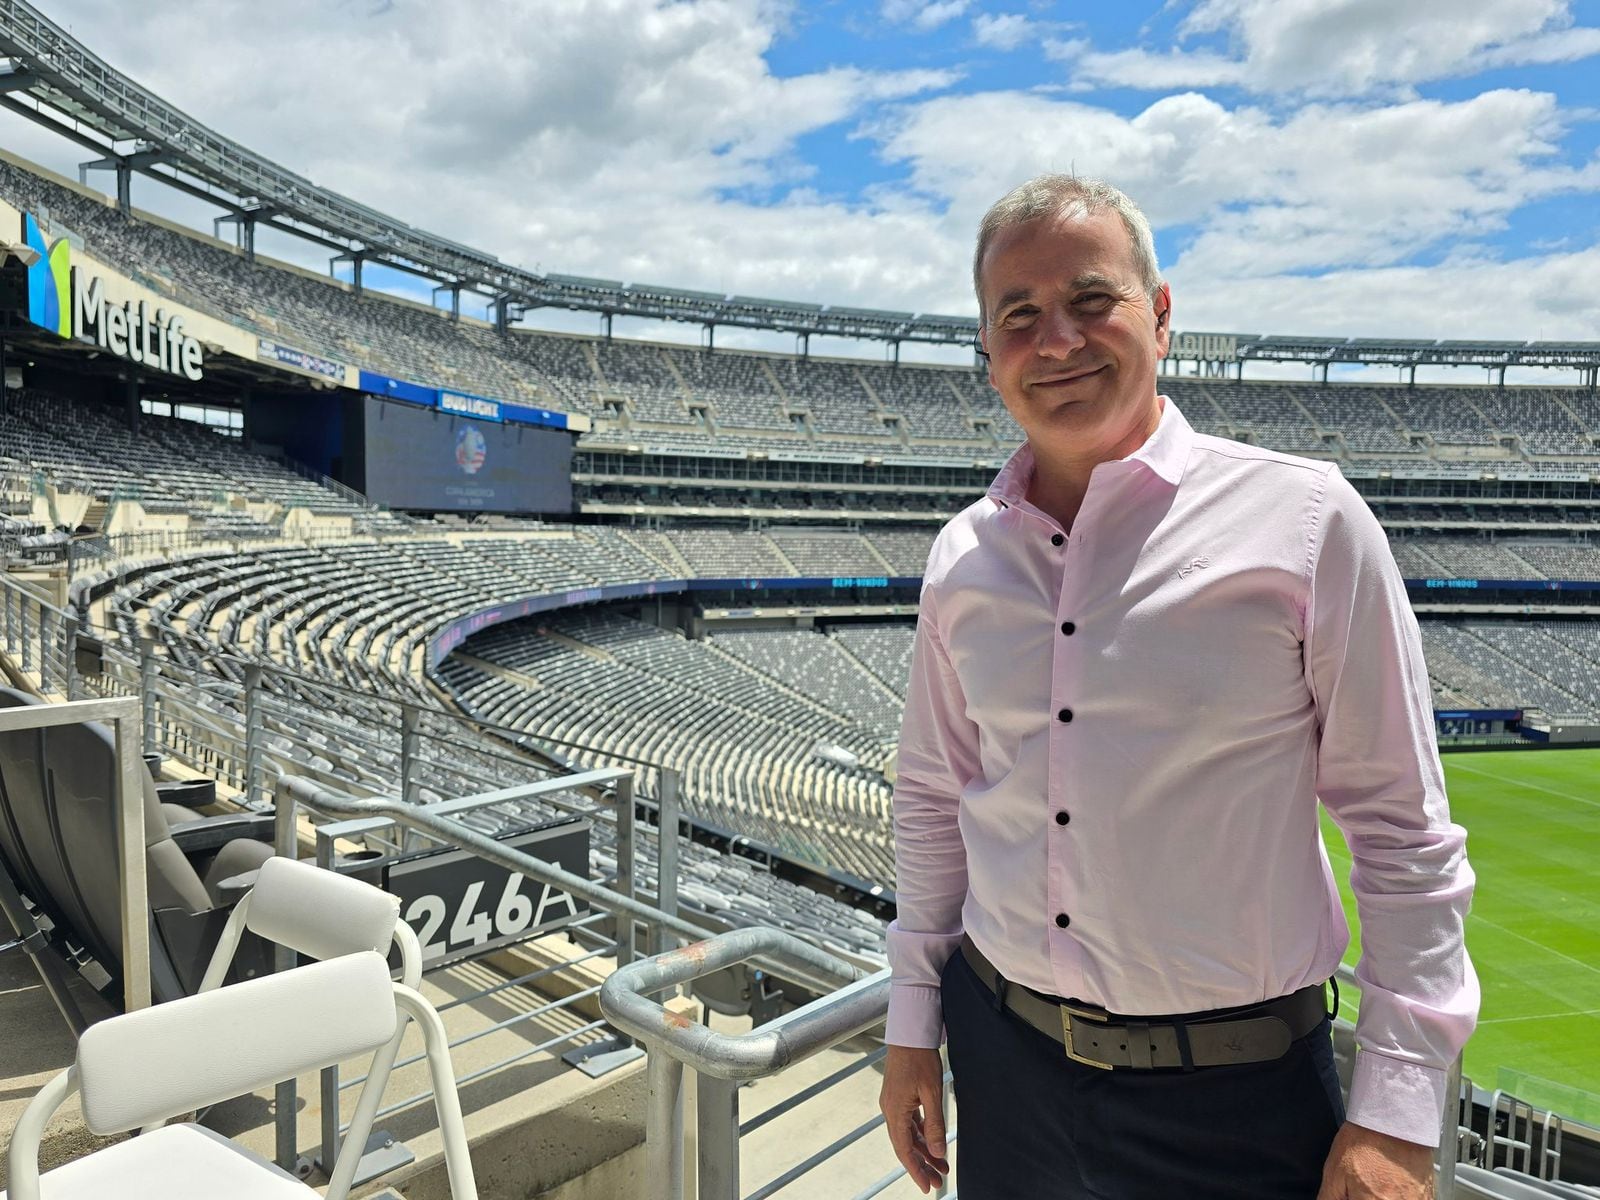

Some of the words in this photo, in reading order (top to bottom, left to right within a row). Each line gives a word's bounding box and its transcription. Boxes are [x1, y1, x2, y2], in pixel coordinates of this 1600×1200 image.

[71, 264, 204, 381] MetLife
[1168, 334, 1237, 362] ADIUM
[404, 862, 577, 960] 246A
